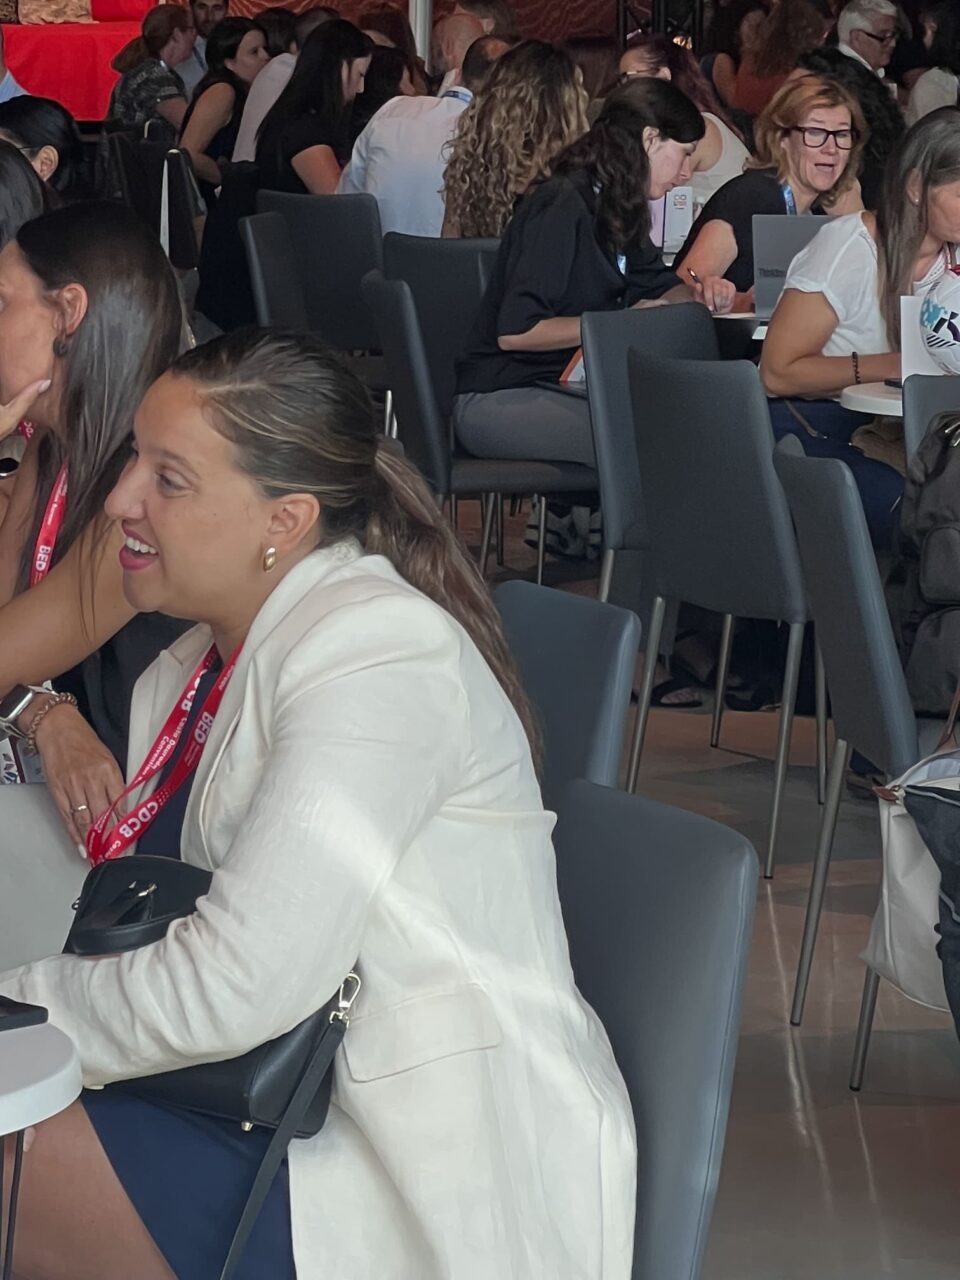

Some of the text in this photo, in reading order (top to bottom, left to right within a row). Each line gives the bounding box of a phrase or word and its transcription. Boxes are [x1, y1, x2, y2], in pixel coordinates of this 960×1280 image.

[35, 545, 51, 571] BED
[194, 711, 215, 744] BED
[119, 801, 159, 838] CDCB
